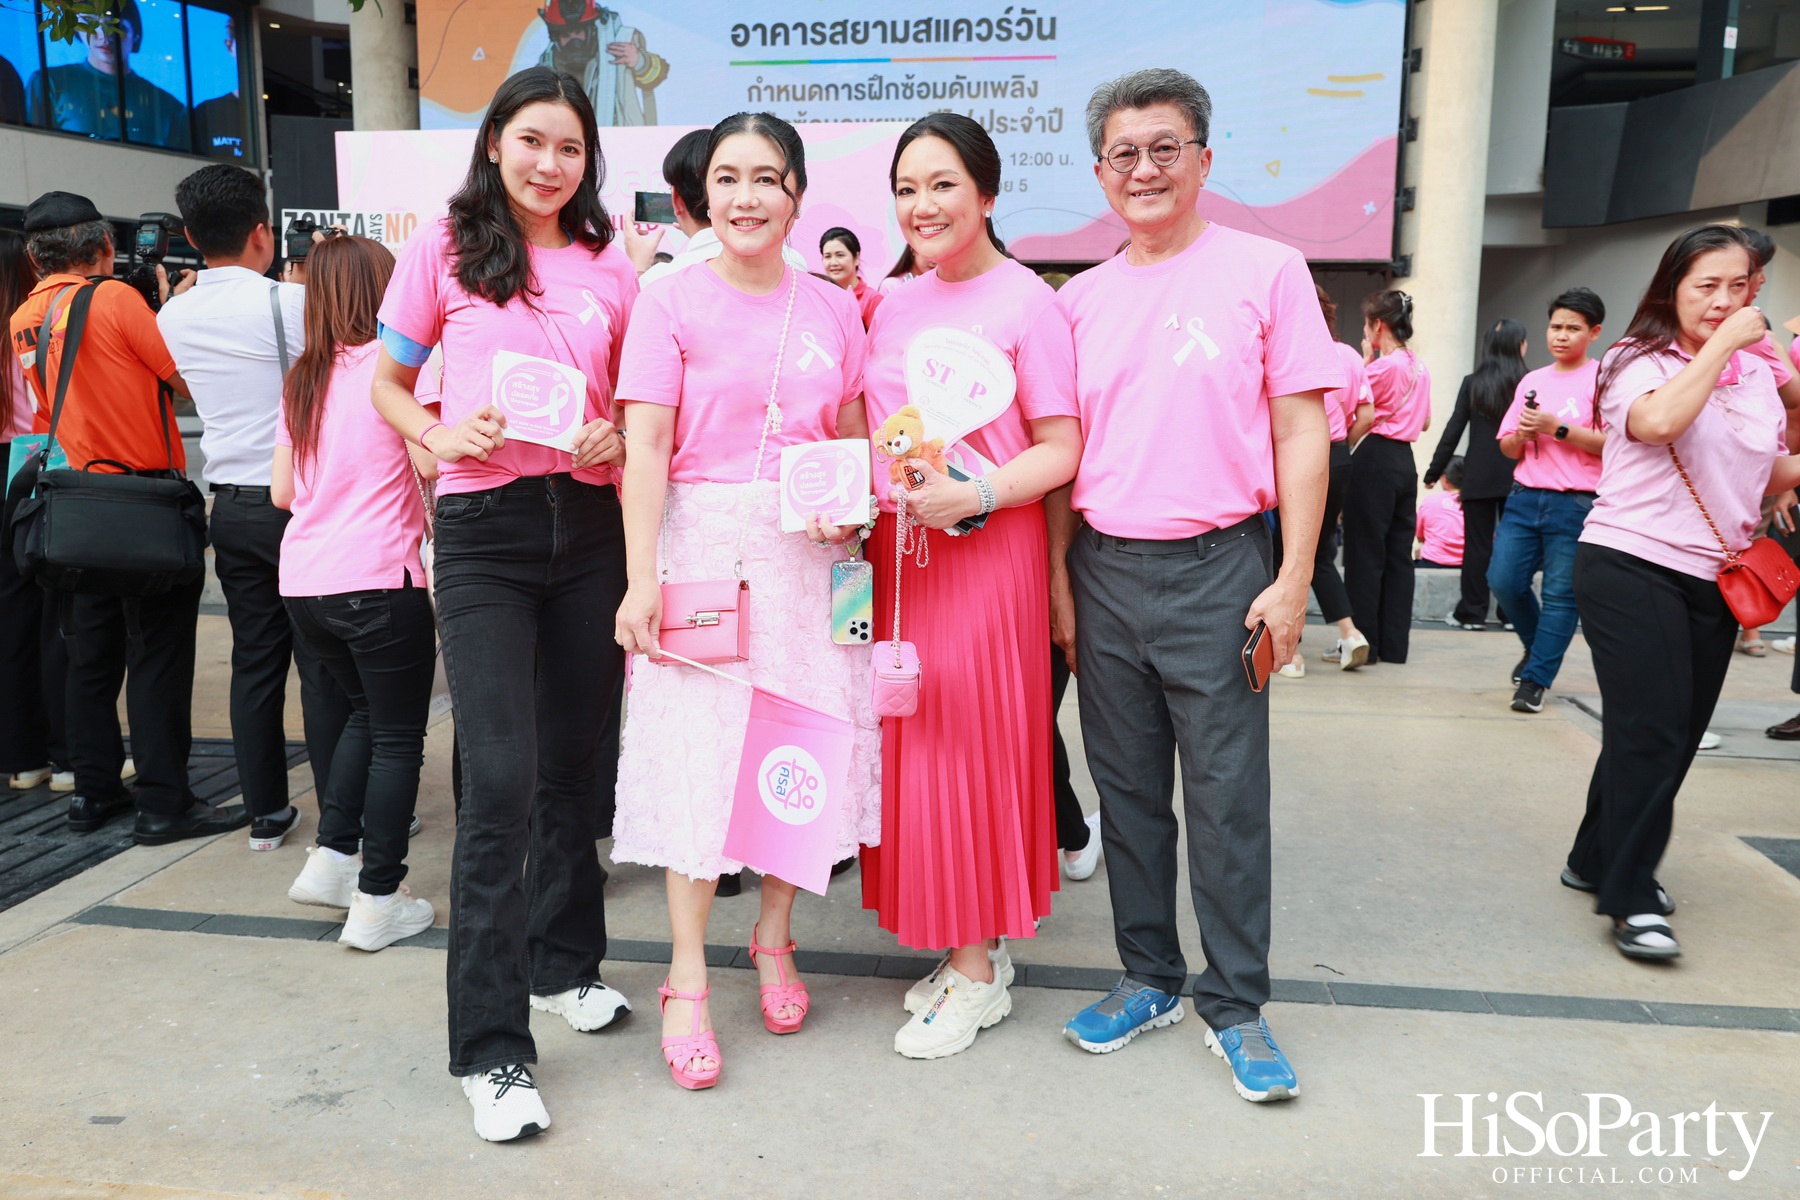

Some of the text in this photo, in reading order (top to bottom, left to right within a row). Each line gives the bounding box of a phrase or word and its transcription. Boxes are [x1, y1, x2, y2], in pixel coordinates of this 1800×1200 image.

[731, 6, 1056, 47] อาคารสยามสแควร์วัน
[747, 74, 1038, 103] กำหนดการฝึกซ้อมดับเพลิง
[1010, 152, 1074, 166] 12:00 น.
[1019, 179, 1028, 192] 5
[385, 212, 417, 243] NO
